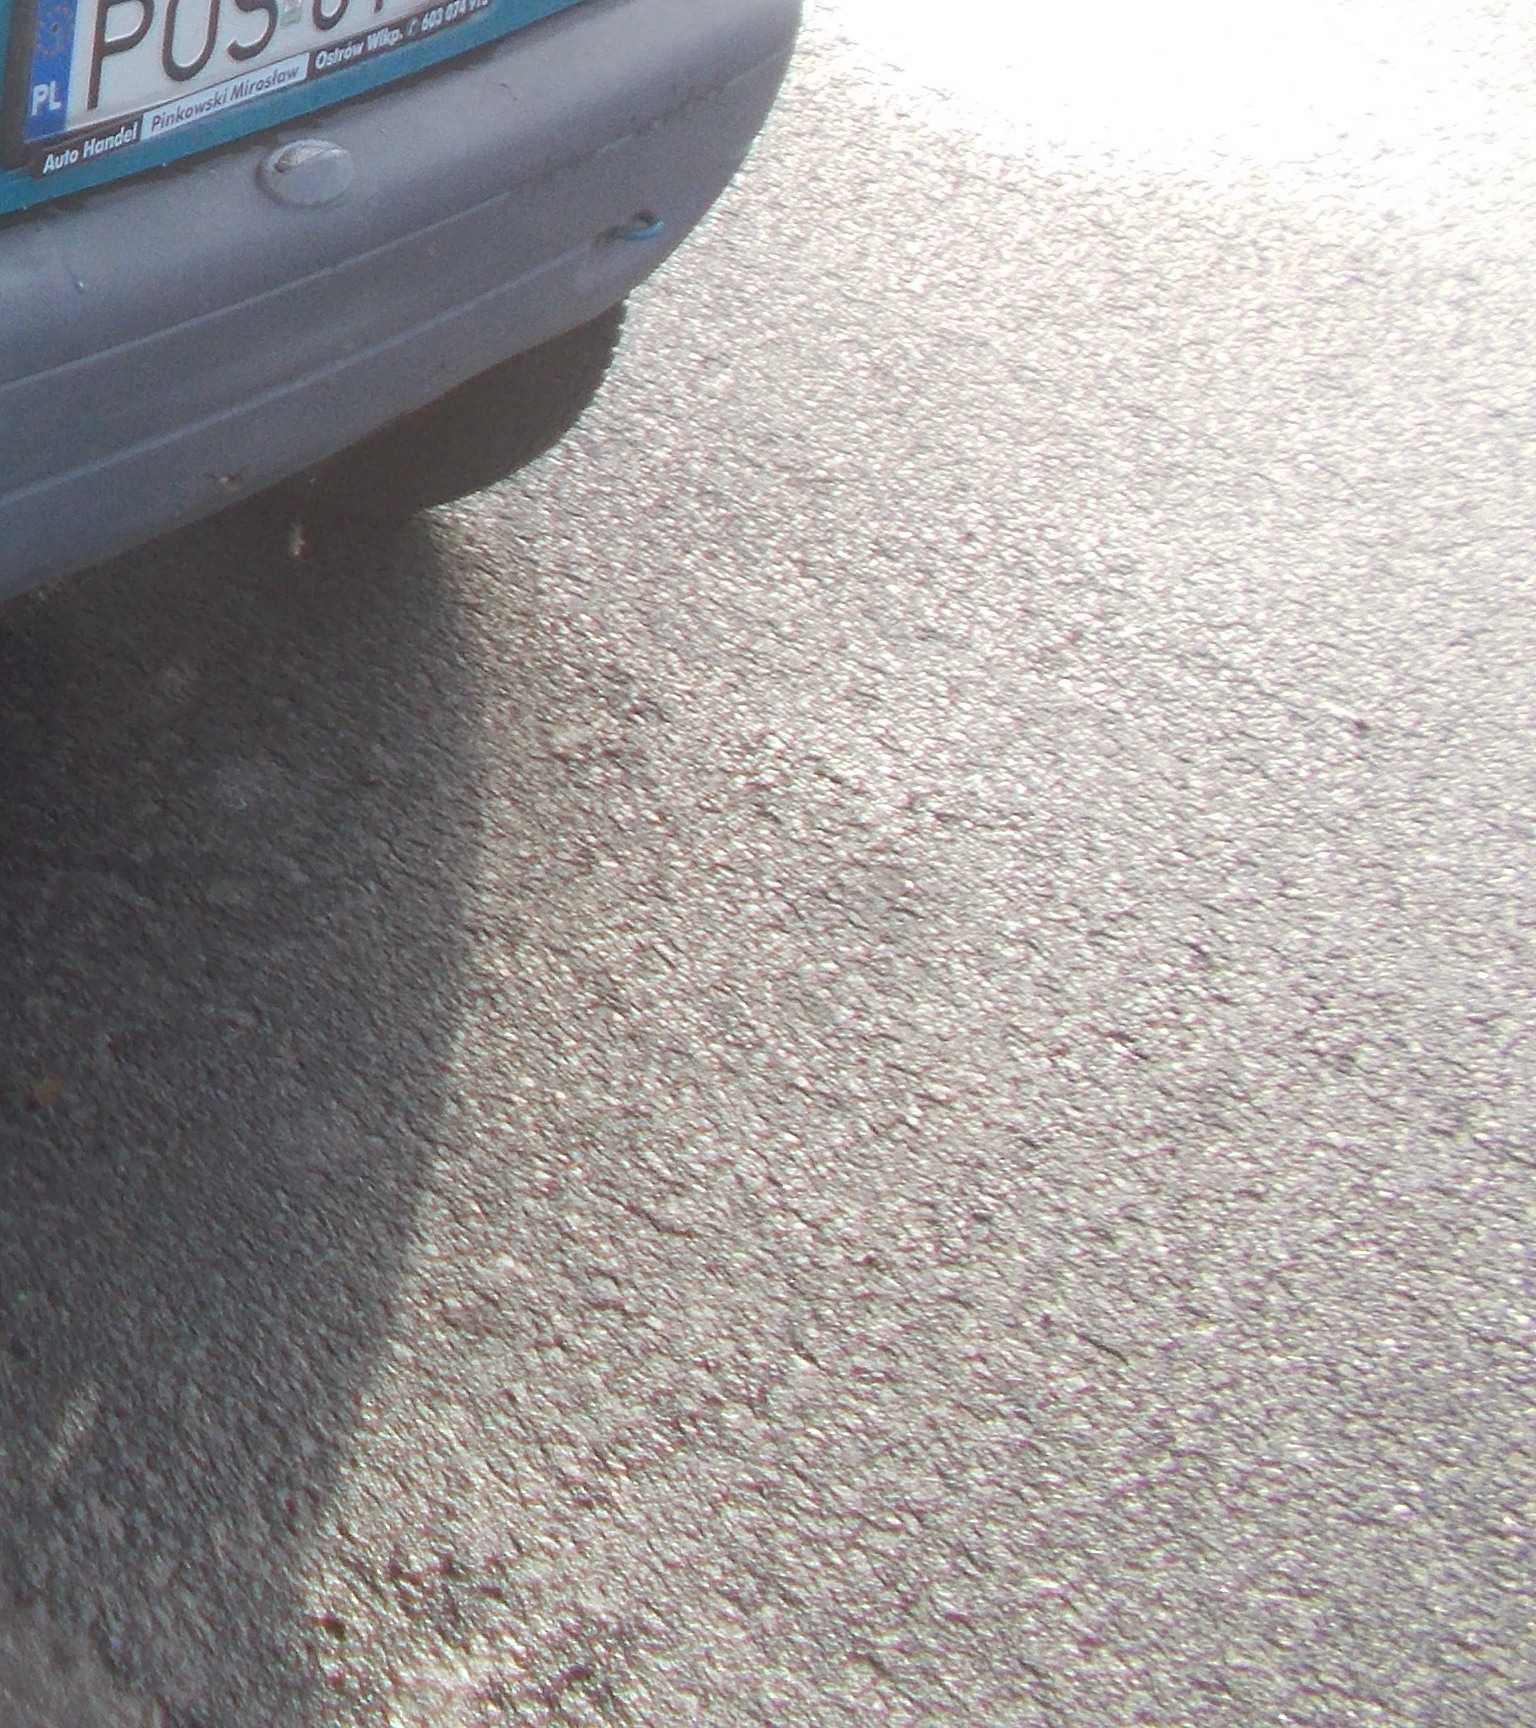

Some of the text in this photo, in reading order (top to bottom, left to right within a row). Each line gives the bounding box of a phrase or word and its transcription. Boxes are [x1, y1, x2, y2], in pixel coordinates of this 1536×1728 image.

[314, 40, 365, 70] Ostrów
[31, 79, 62, 116] PL
[150, 66, 299, 132] Pinkowski Mirosław
[42, 121, 140, 174] Auto Handel
